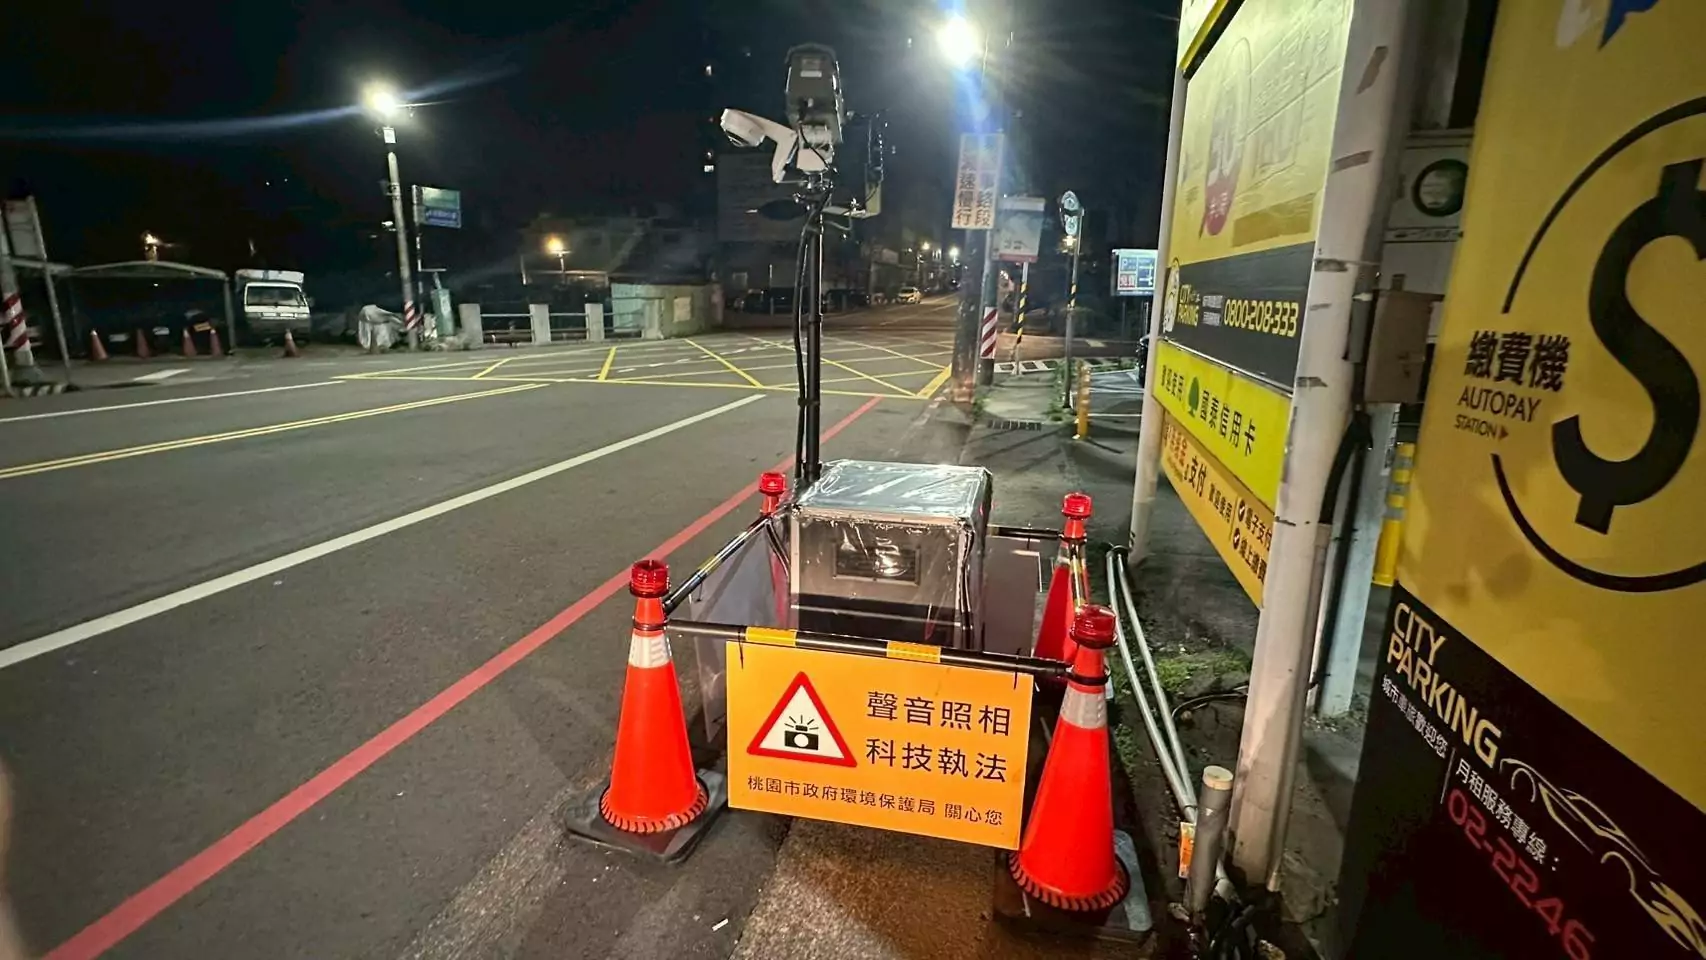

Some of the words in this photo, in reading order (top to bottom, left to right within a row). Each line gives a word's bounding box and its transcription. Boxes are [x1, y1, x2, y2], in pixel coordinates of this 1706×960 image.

[1224, 299, 1299, 337] 0800-208-333
[1464, 330, 1571, 392] 繳費機
[1454, 414, 1497, 439] STATION
[1457, 386, 1542, 422] AUTOPAY
[1394, 603, 1446, 666] CITY
[867, 690, 1010, 736] 聲音照相
[1387, 632, 1502, 768] PARKING
[866, 738, 1007, 783] 科技執法
[748, 775, 936, 815] 桃園市政府環境保護局
[944, 803, 1003, 826] 關心您
[1449, 788, 1595, 960] 02-2246
